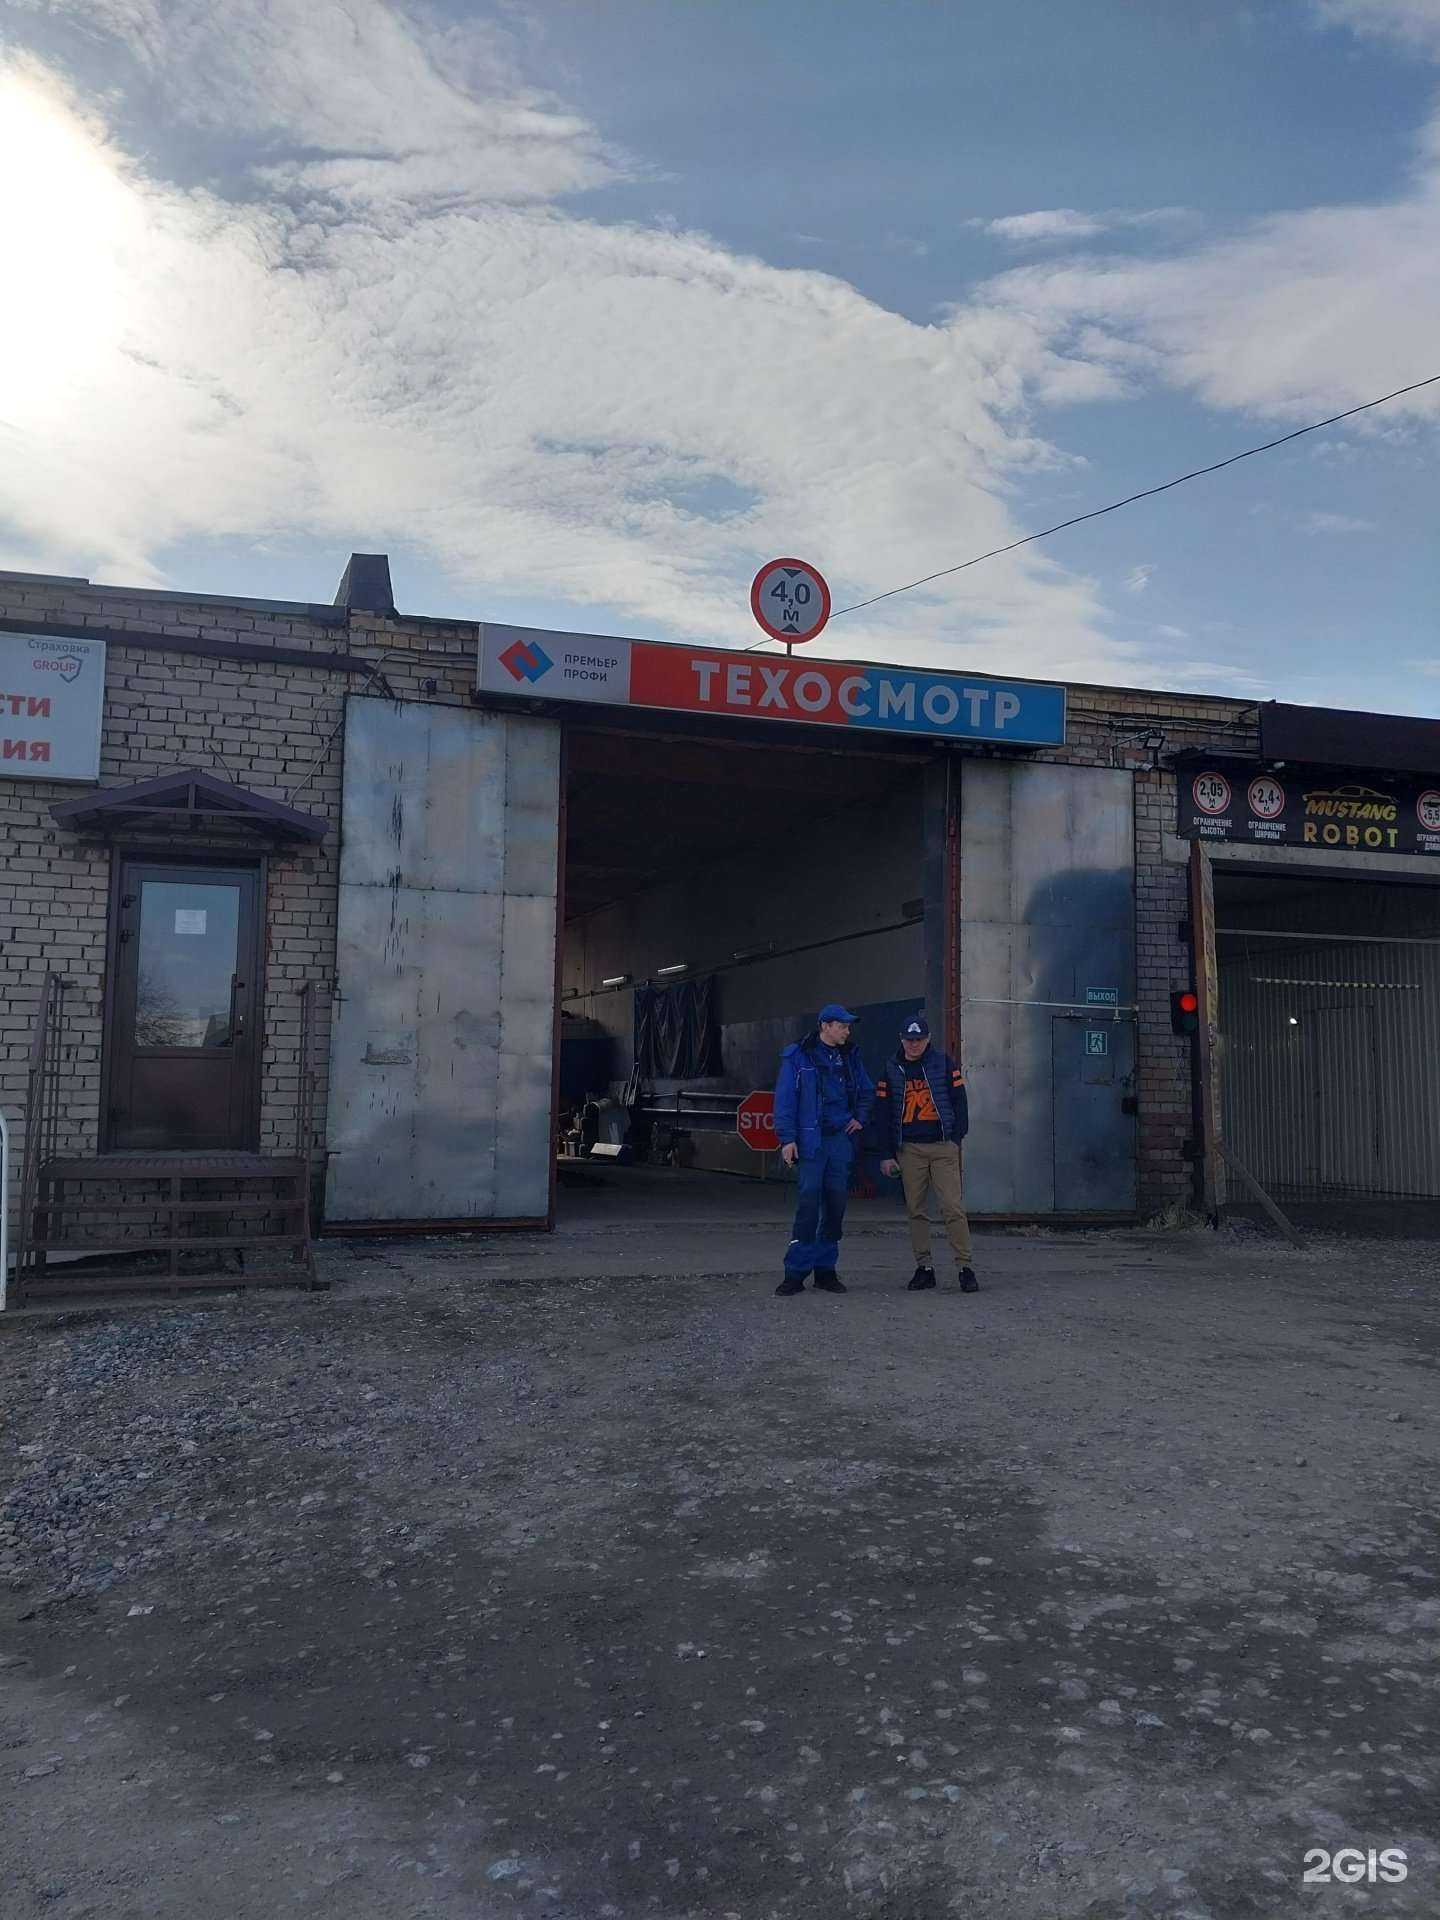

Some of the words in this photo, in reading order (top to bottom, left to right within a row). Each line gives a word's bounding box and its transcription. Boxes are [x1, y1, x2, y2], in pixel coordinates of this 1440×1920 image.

[770, 581, 811, 609] 4,0
[32, 659, 77, 672] GROUP
[564, 654, 618, 668] ПРЕМЬЕР
[563, 668, 608, 681] ПРОФИ
[691, 660, 1021, 729] ТЕХОСМОТР
[1200, 781, 1224, 799] 2,05
[1305, 800, 1397, 821] MUSTANG
[1193, 816, 1233, 828] ОГРАНИЧЕНИЕ
[1248, 820, 1287, 831] ОГРАНИЧЕНИЕ
[1200, 826, 1226, 836] ВЫСОТЫ
[1304, 822, 1398, 848] ROBOT
[740, 1111, 775, 1130] STO
